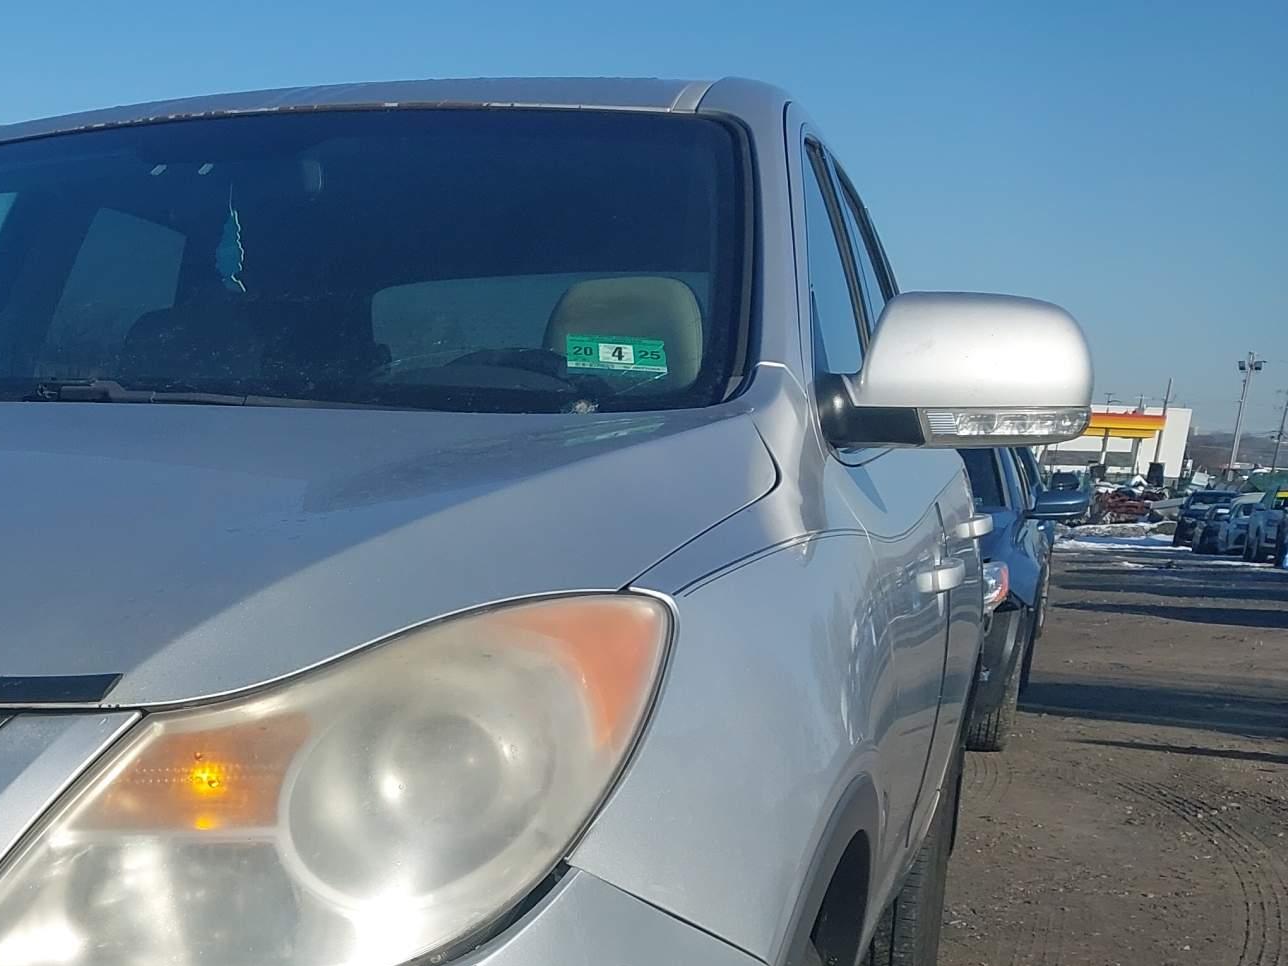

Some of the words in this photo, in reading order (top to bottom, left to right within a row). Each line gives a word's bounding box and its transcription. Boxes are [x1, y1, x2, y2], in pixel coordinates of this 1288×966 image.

[573, 346, 593, 356] 20
[612, 346, 624, 361] 4
[638, 350, 661, 360] 25
